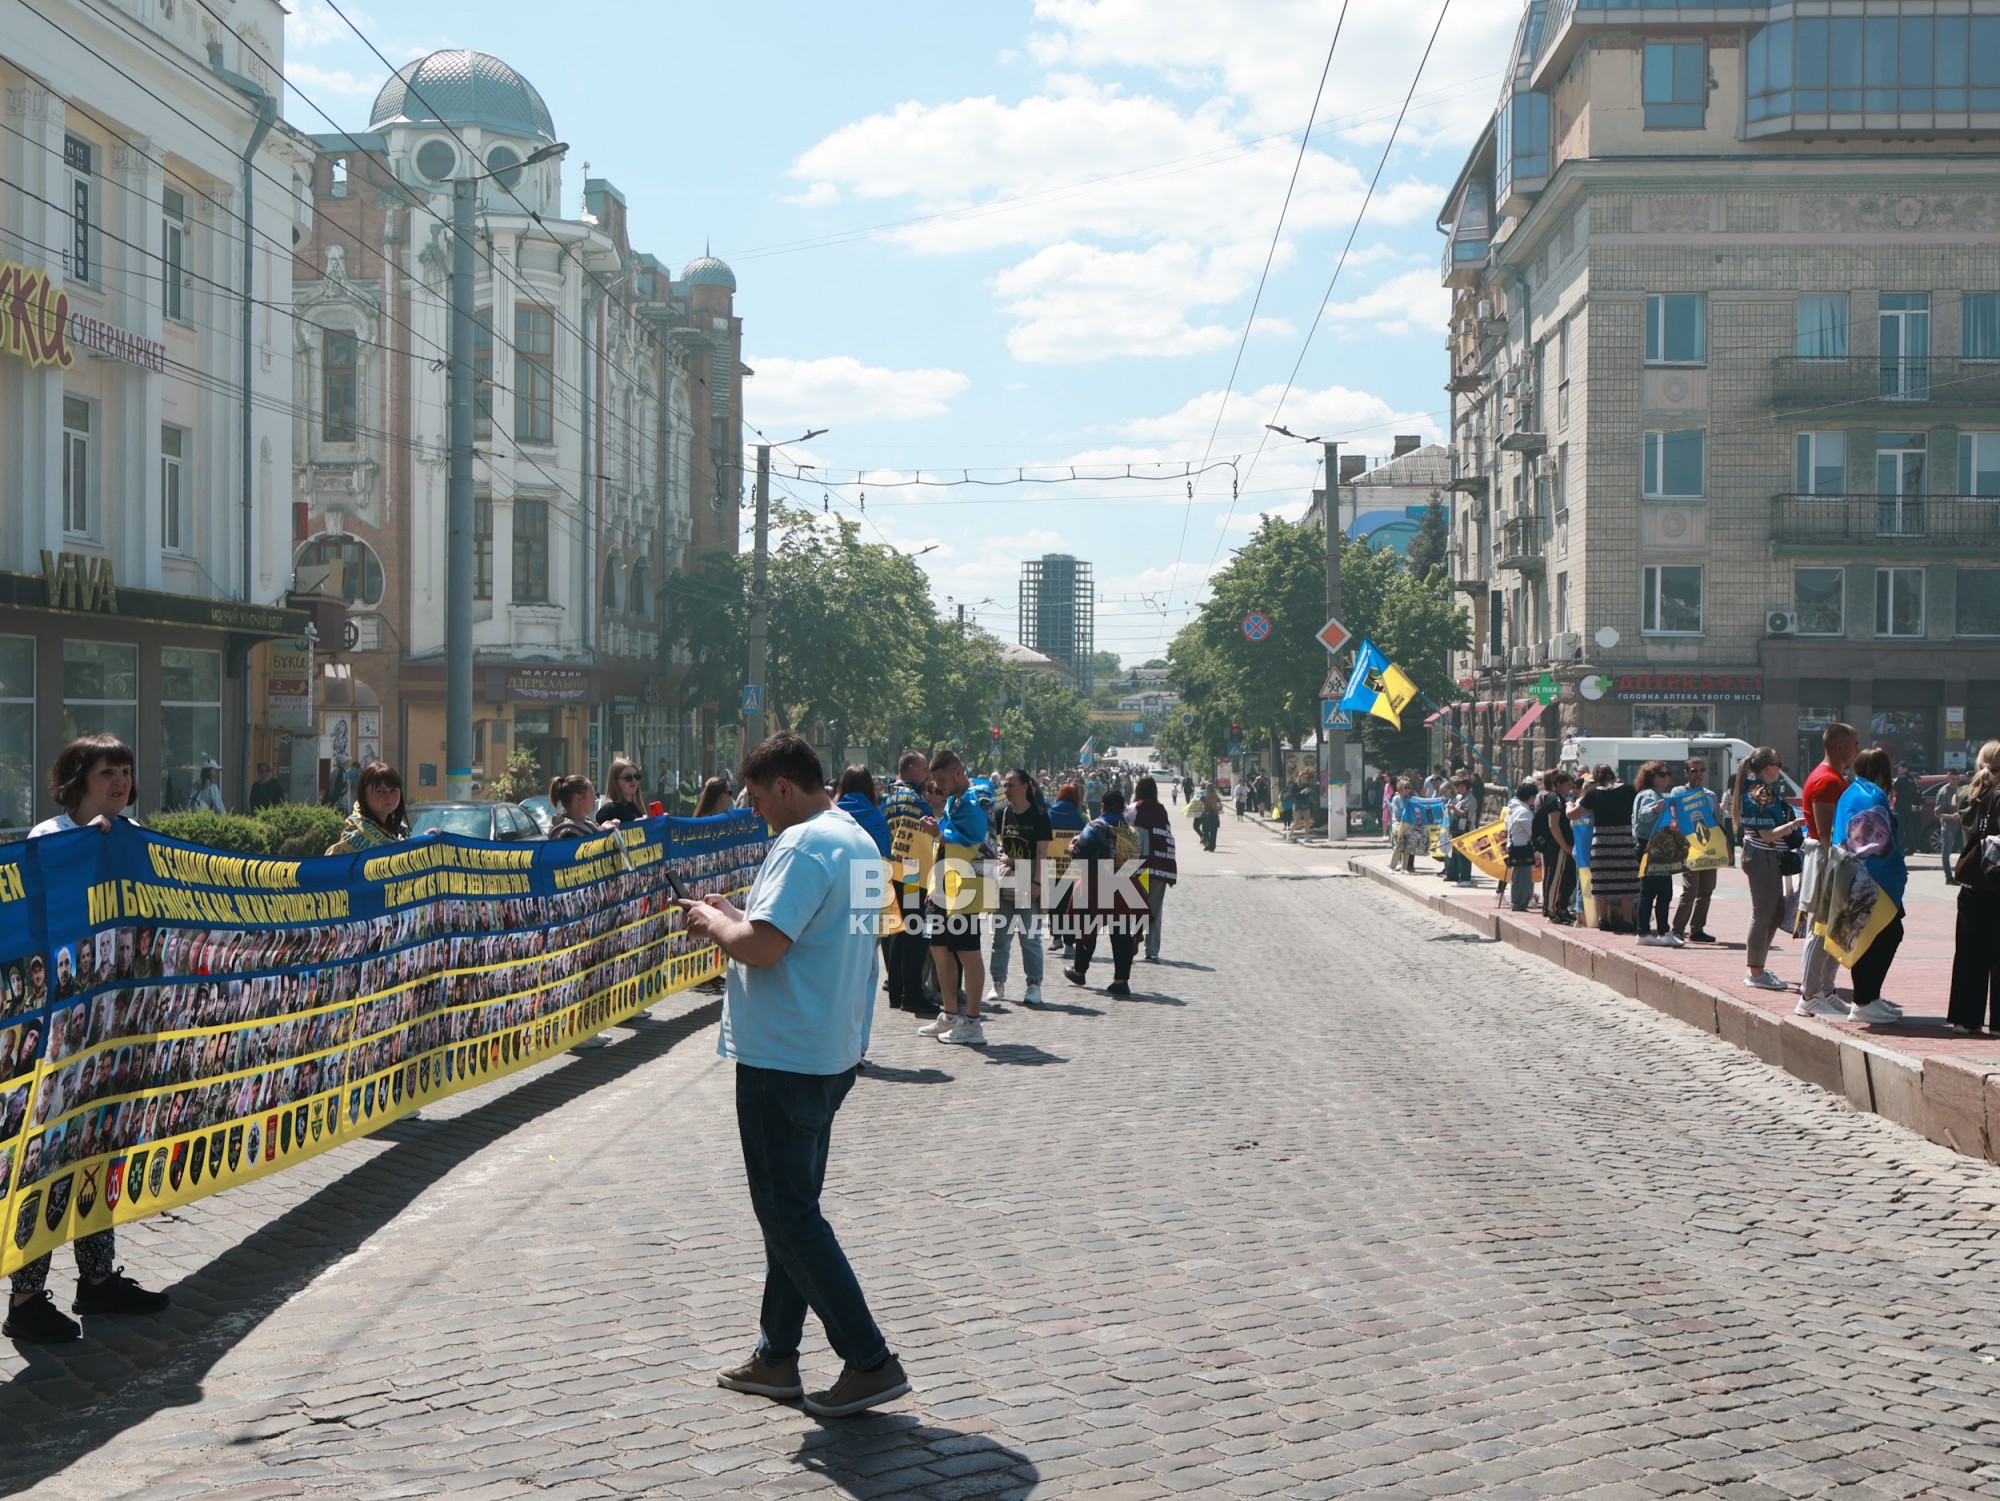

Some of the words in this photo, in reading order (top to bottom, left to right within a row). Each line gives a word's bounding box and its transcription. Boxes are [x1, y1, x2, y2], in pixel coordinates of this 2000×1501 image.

[70, 312, 166, 373] СУПЕРМАРКЕТ
[273, 655, 305, 669] БУКИ
[522, 669, 581, 677] МАГАЗИН
[1619, 674, 1713, 691] АПТЕКА
[148, 843, 212, 887] ОБ'ЄДНАНІ
[209, 854, 246, 888] ВІРОЮ
[245, 859, 260, 888] ТА
[87, 880, 118, 926] МИ
[121, 879, 204, 921] БОРЕМОСЯ
[194, 891, 220, 922] ЗА
[209, 893, 245, 926] ВАС,
[234, 894, 258, 923] ЯК
[248, 894, 271, 923] ВИ
[313, 892, 330, 920] ЗА
